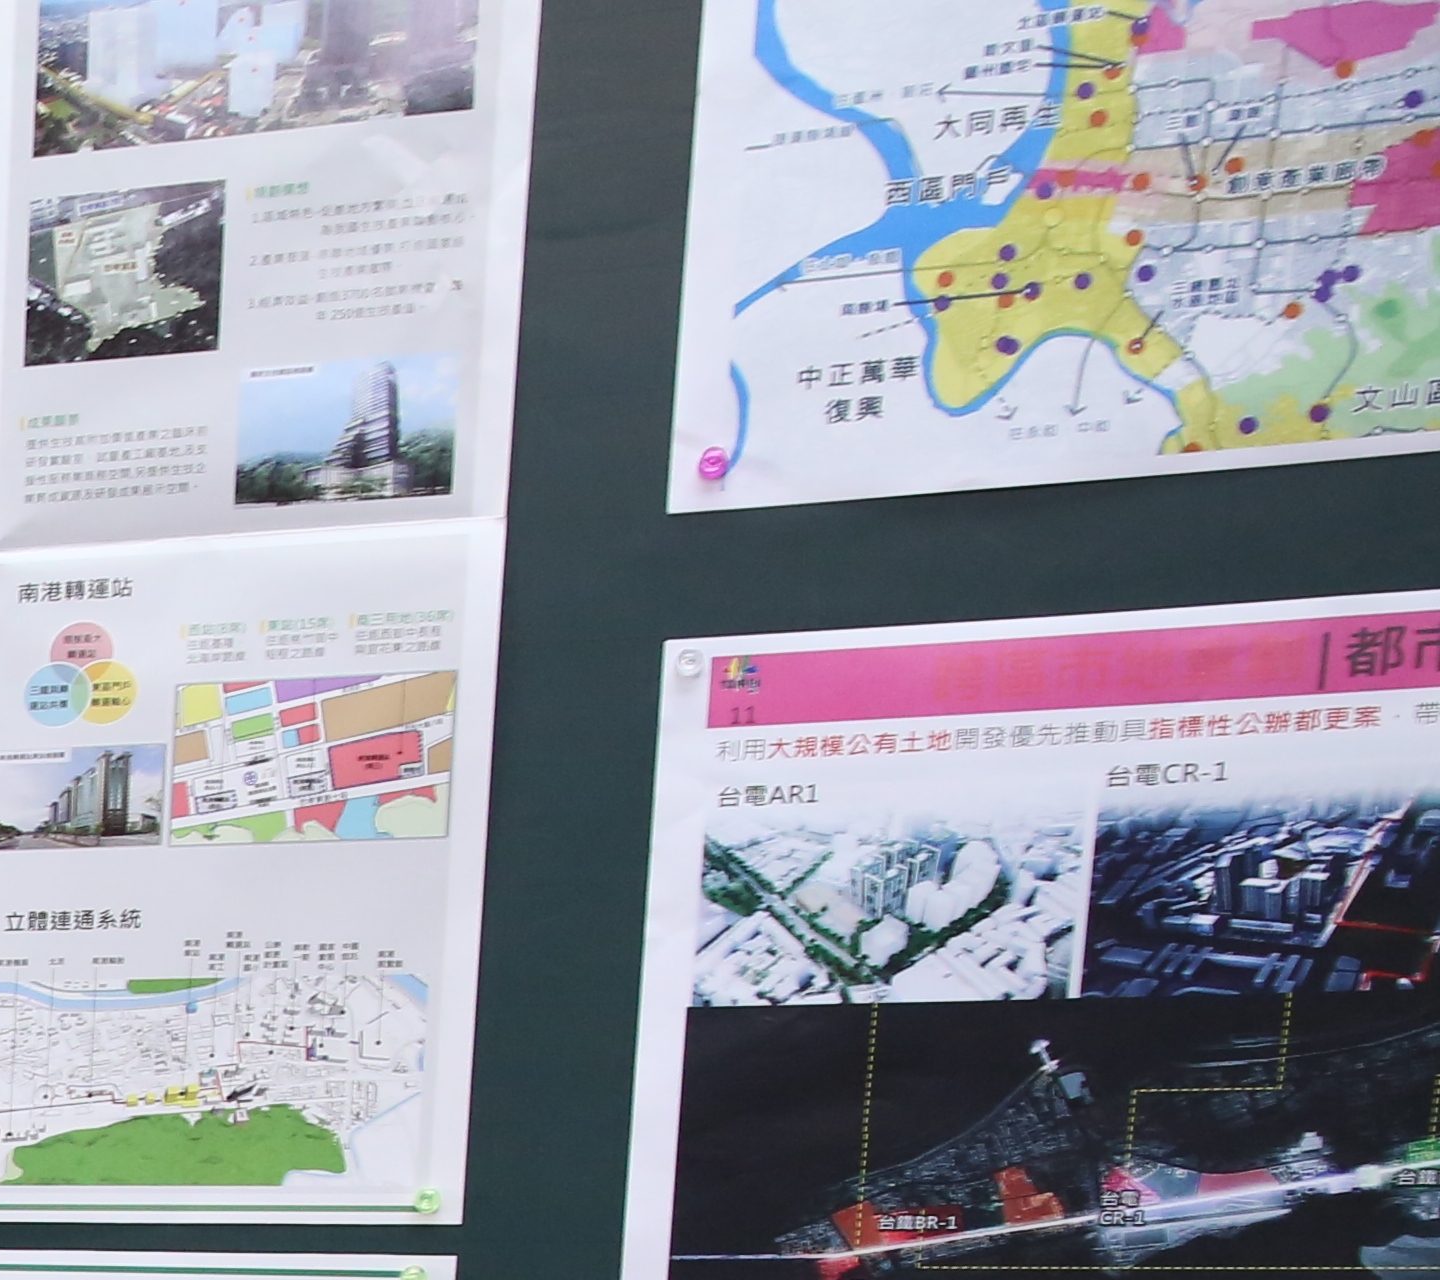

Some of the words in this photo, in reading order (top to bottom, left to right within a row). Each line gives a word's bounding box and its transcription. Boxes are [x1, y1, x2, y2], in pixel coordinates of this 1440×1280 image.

[934, 101, 1062, 141] 大同再生
[886, 168, 1015, 205] 西區門戶
[1228, 158, 1384, 194] 創意產業廊帶
[798, 355, 919, 389] 中正萬華
[825, 396, 885, 424] 復興
[17, 577, 134, 604] 南港轉運站
[730, 706, 758, 725] 11
[1106, 761, 1229, 788] 台電CR-1
[718, 784, 820, 808] 台電AR1
[4, 908, 142, 933] 立體連通系統
[1102, 1191, 1139, 1207] 台電
[1100, 1208, 1145, 1227] CR-1
